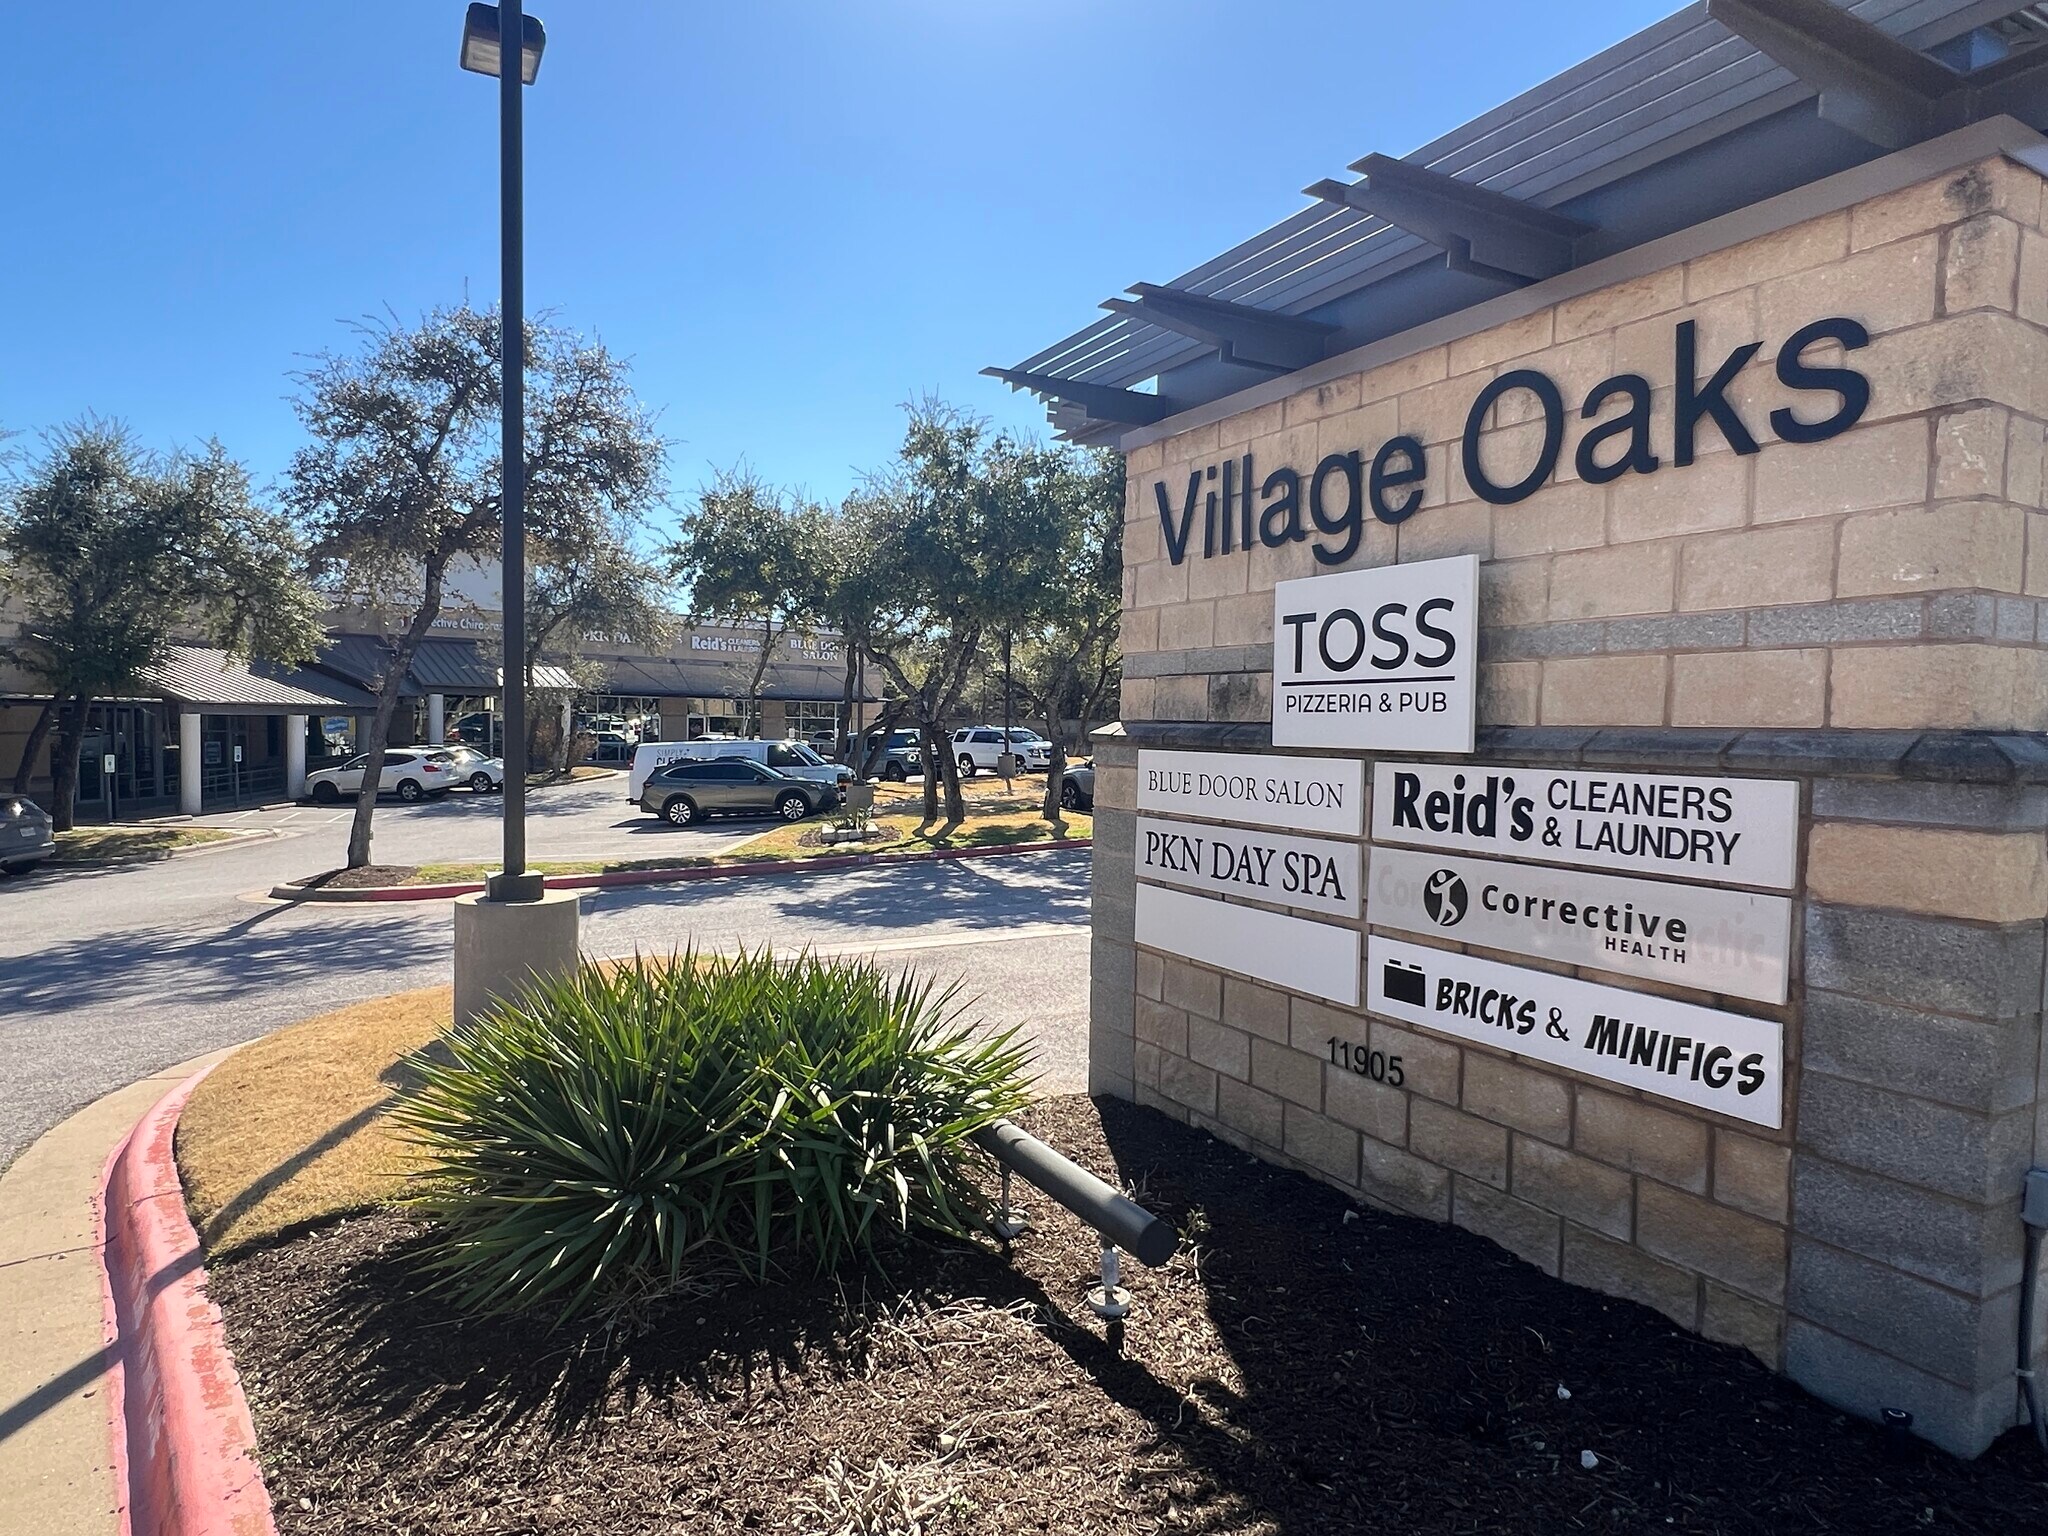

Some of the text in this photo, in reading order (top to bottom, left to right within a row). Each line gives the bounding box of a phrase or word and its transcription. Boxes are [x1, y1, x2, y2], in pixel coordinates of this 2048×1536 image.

[1154, 317, 1871, 566] Village Oaks
[691, 636, 727, 651] Reid's
[790, 639, 818, 650] BLUE
[802, 650, 838, 661] SALON
[1282, 597, 1456, 674] TOSS
[1284, 691, 1447, 714] PIZZERIA & PUB
[656, 748, 683, 757] SIMPLY
[1148, 770, 1344, 809] BLUE DOOR SALON
[1392, 771, 1734, 842] Reid's CLEANERS
[1144, 831, 1204, 875] PKN
[1210, 841, 1277, 887] DAY
[1282, 850, 1347, 901] SPA
[1541, 816, 1742, 866] & LAUNDRY
[1481, 884, 1687, 943] Corrective
[1605, 936, 1687, 964] HEALTH
[1326, 1035, 1405, 1088] 11905
[1435, 977, 1766, 1096] BRICKS & MINIFIGS
